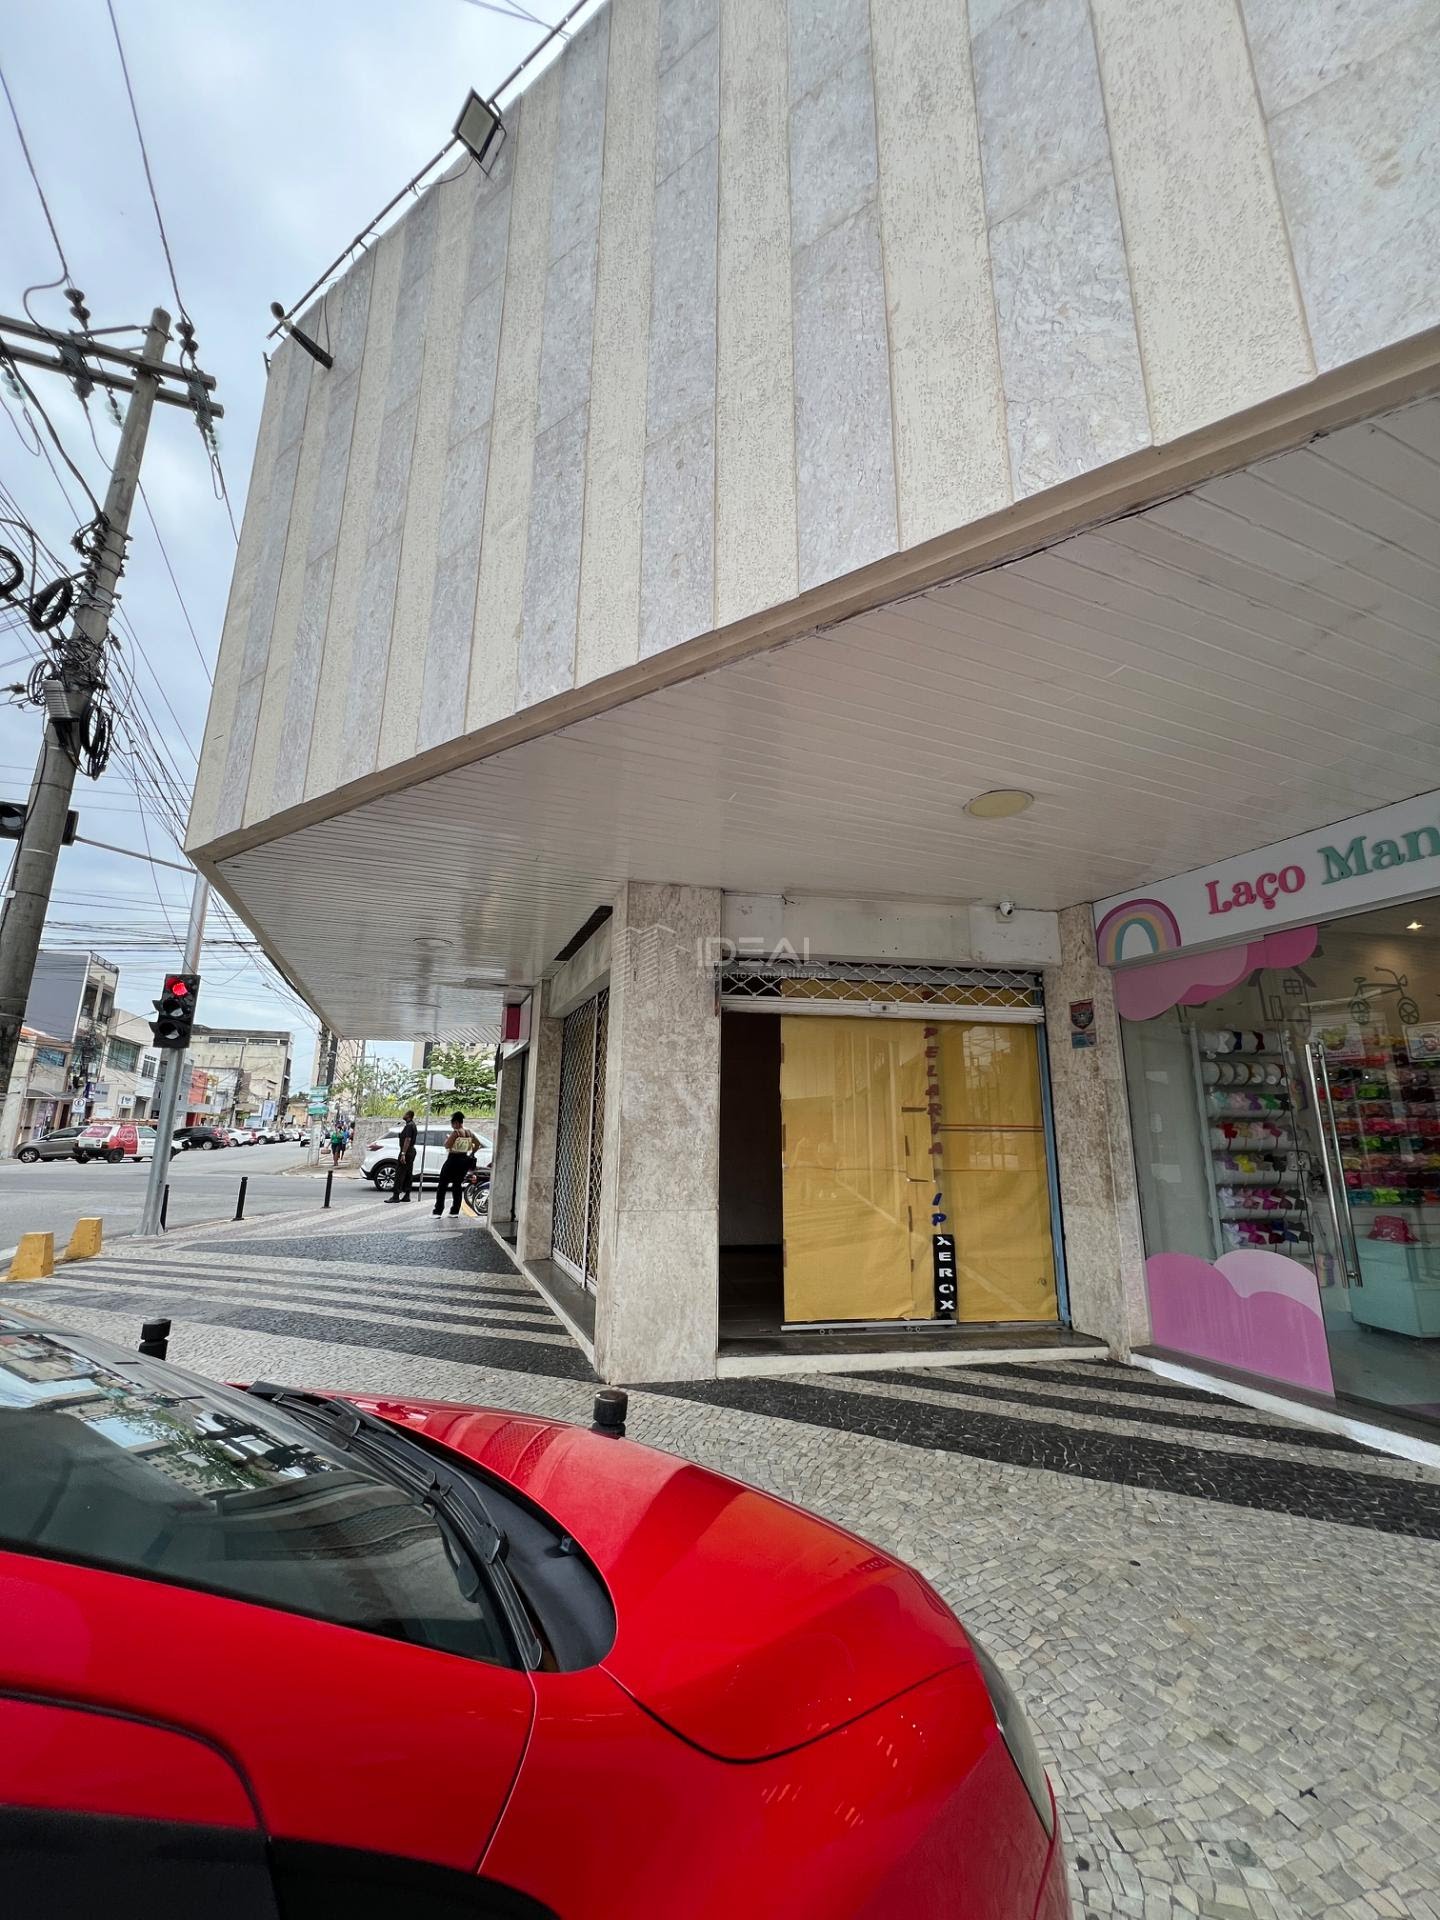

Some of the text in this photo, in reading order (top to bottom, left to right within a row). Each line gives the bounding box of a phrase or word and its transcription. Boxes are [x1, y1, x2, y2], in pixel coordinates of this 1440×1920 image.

[1204, 825, 1440, 915] Laço Man
[936, 1236, 955, 1310] XEROX
